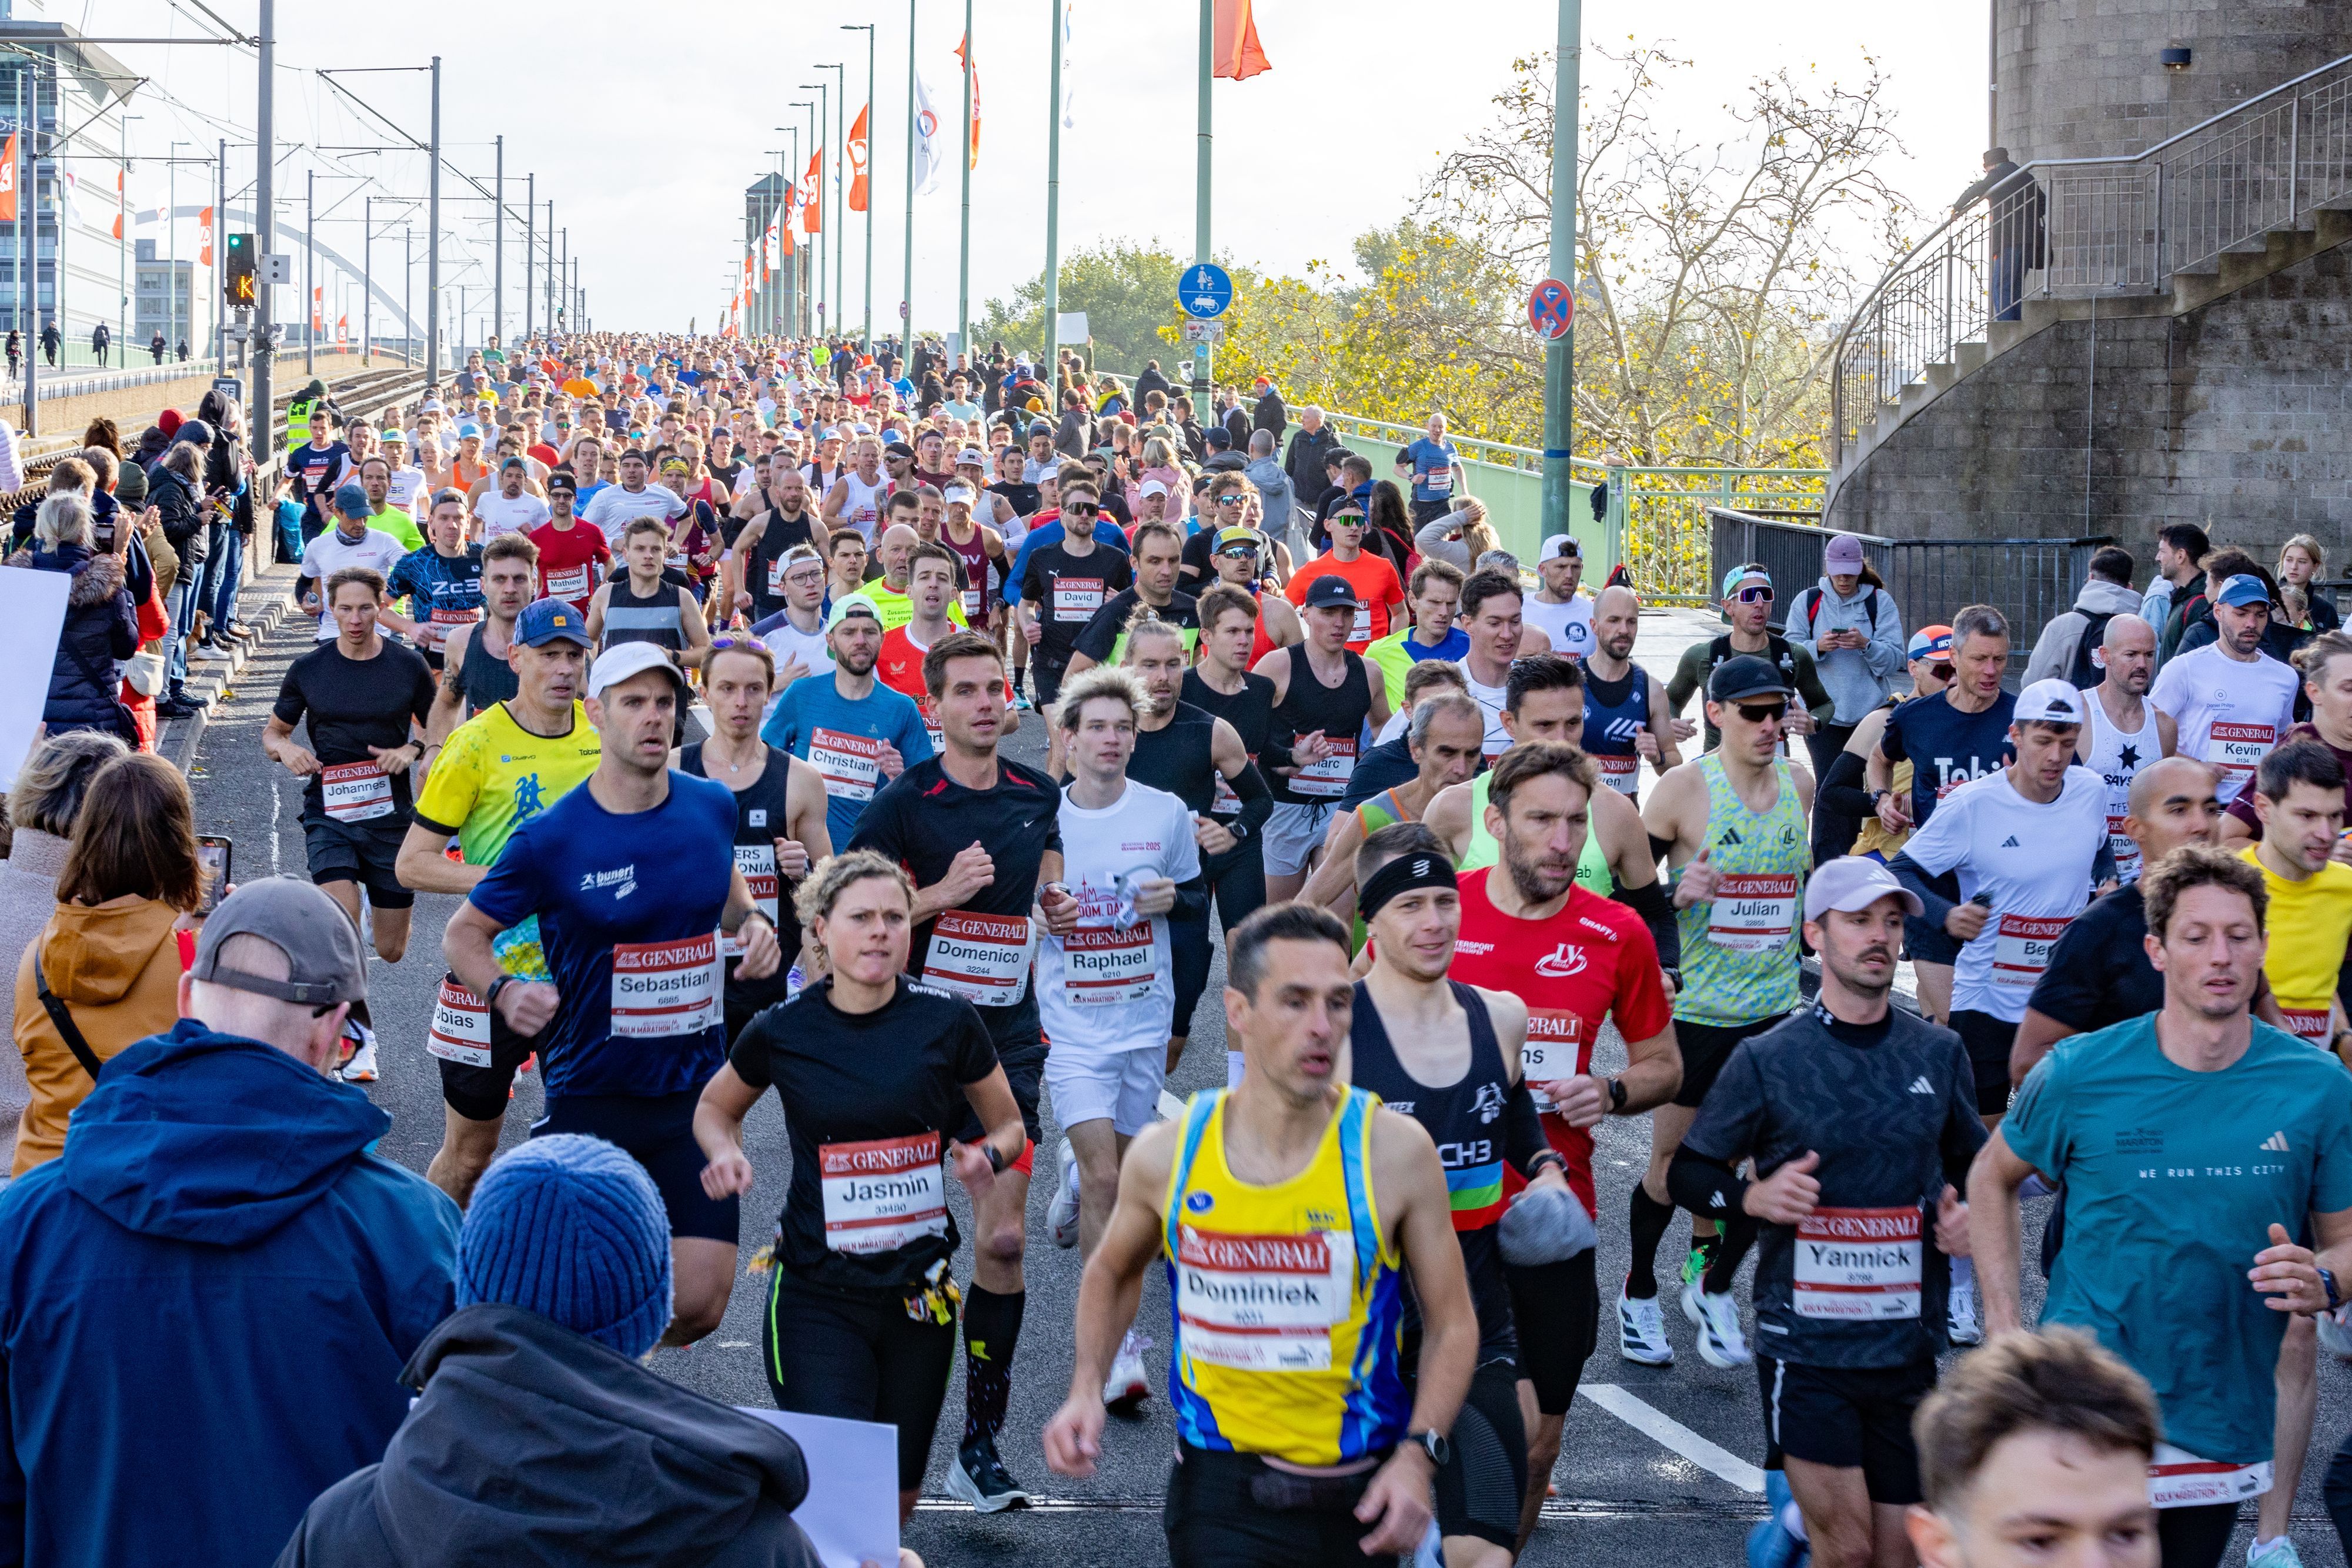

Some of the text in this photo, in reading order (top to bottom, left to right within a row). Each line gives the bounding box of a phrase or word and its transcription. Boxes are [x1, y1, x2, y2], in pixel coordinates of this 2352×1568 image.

[240, 275, 255, 298] K
[550, 579, 581, 587] Mathieu
[1065, 581, 1101, 590] GENERALI
[1065, 592, 1093, 601] David
[2228, 727, 2274, 740] GENERALI
[2225, 743, 2261, 756] Kevin
[814, 750, 874, 773] Christian
[328, 780, 386, 796] Johannes
[1145, 841, 1161, 851] 2025
[739, 862, 773, 874] ONIA
[1738, 880, 1796, 894] GENERALI
[1107, 901, 1124, 917] DA
[1730, 900, 1780, 917] Julian
[961, 920, 1027, 940] GENERALI
[1578, 917, 1613, 937] CRAFT
[1085, 927, 1150, 946] GENERALI
[642, 941, 714, 968] GENERALI
[937, 940, 1020, 964] Domenico
[1073, 948, 1148, 972] Raphael
[965, 965, 991, 975] 32244
[1102, 970, 1121, 979] 6210
[620, 971, 710, 992] Sebastian
[1087, 994, 1115, 1004] MARATHON
[439, 1025, 454, 1035] 6361
[637, 1025, 671, 1034] MARATHON
[463, 1055, 479, 1064] PUMA
[853, 1140, 937, 1170] GENERALI
[2139, 1165, 2285, 1178] WE RUN THIS CITY
[842, 1174, 930, 1202] Jasmin
[1828, 1215, 1919, 1237] GENERALI
[858, 1240, 897, 1252] MARATHON
[1208, 1238, 1327, 1269] GENERALI
[1808, 1243, 1911, 1268] Yannick
[1187, 1269, 1321, 1306] Dominiek
